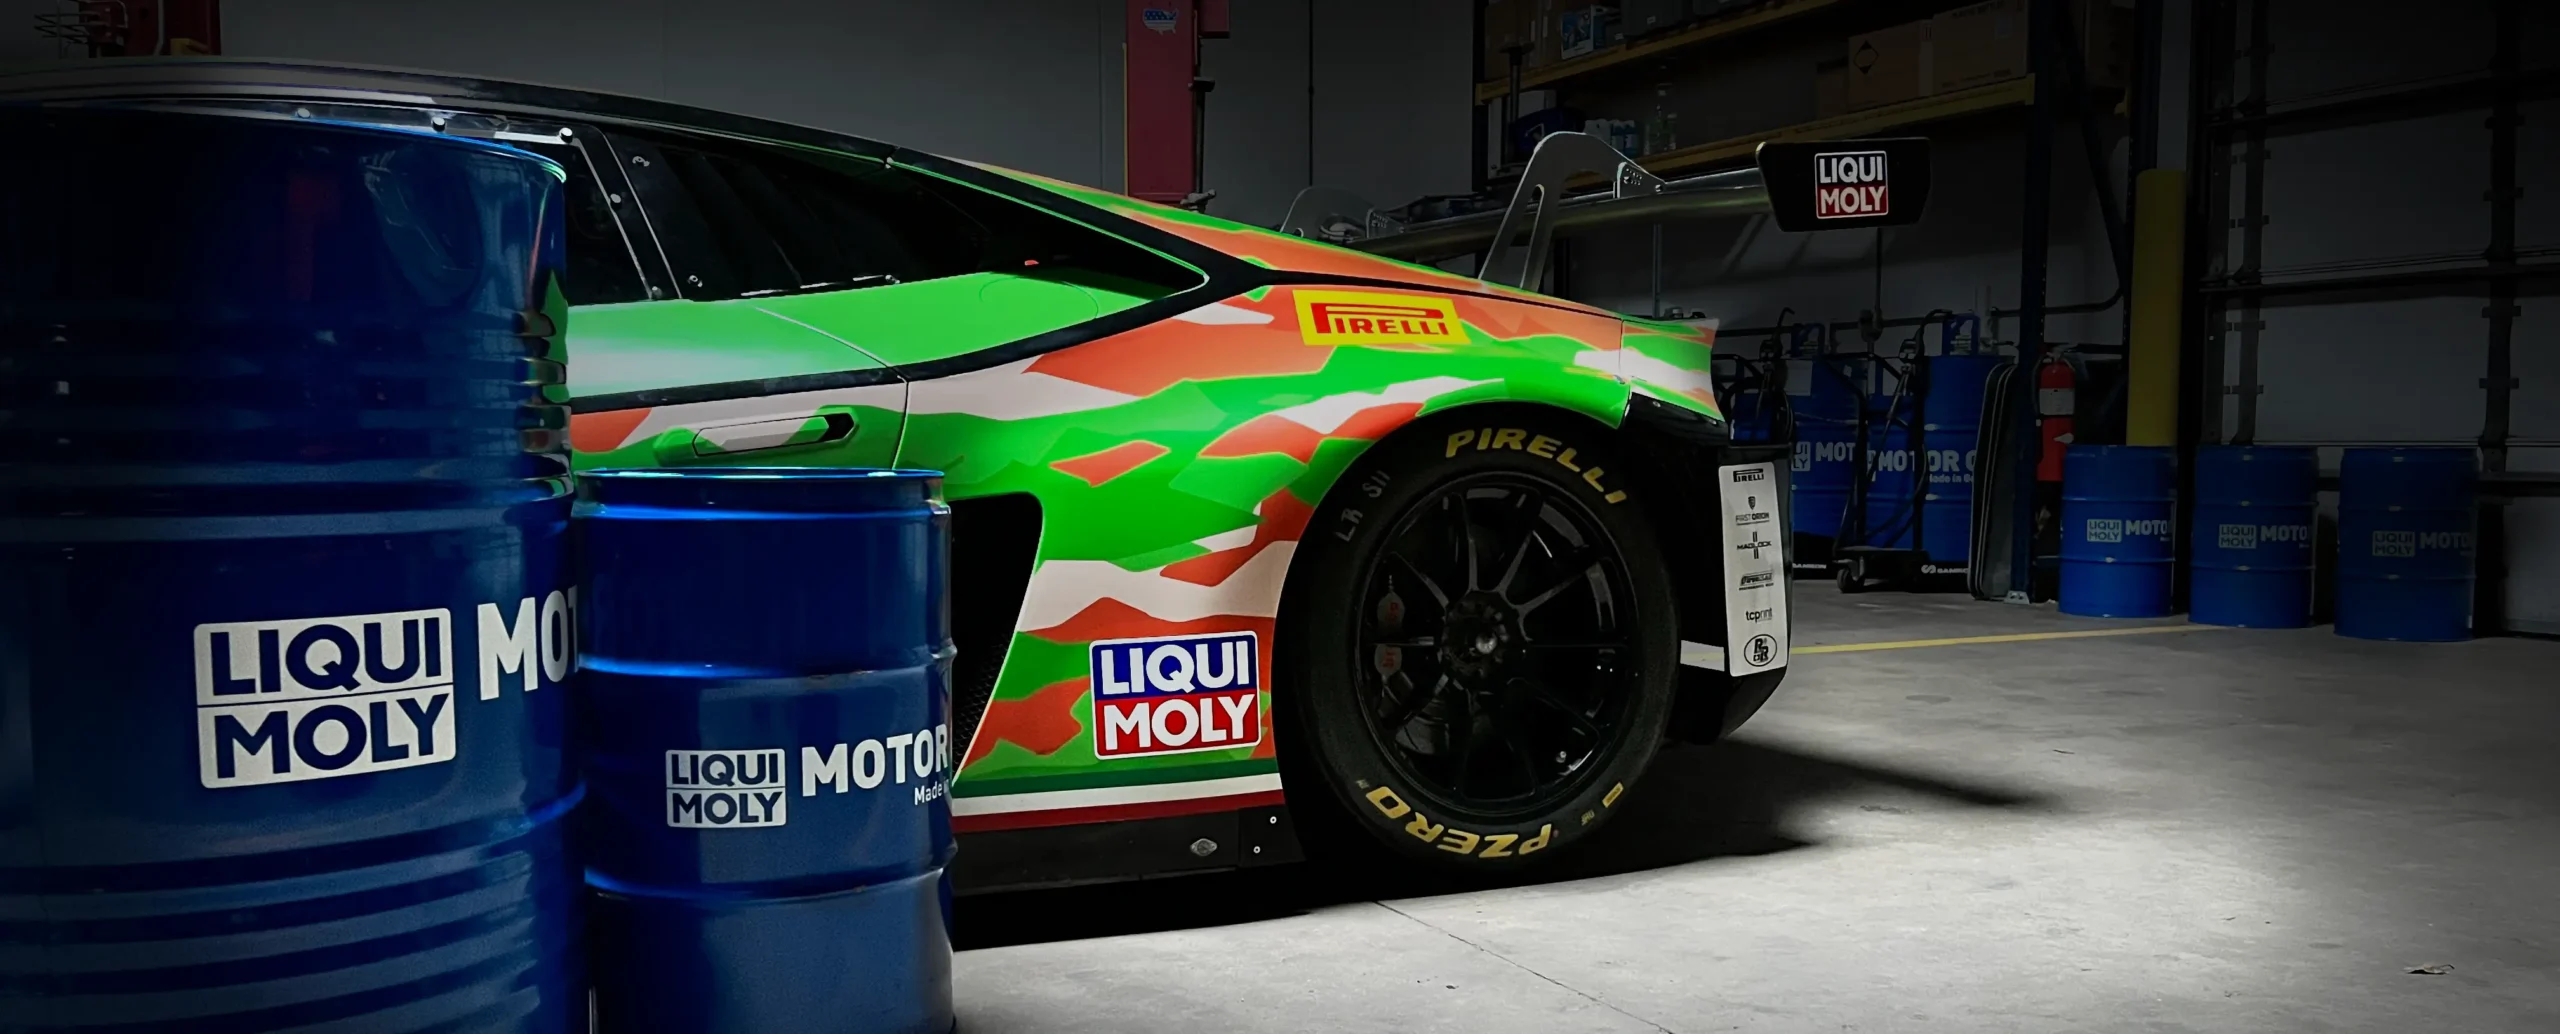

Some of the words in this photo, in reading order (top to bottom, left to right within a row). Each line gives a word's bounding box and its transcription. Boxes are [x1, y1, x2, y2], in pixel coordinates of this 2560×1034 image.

[1820, 156, 1883, 184] LIQUI
[1820, 186, 1886, 214] MOLY
[1310, 303, 1449, 335] PIRELLI
[1445, 427, 1627, 504] PIRELLI
[1733, 468, 1764, 482] PIRELLI
[2089, 521, 2119, 531] LIQUI
[2089, 531, 2119, 541] MOLY
[2221, 526, 2254, 536] LIQUI
[2375, 533, 2412, 543] LIQUI
[2221, 537, 2254, 547] MOLY
[2375, 544, 2412, 555] MOLY
[210, 617, 442, 696] LIQUI
[1101, 640, 1249, 695] LIQUI
[214, 693, 449, 778] MOLY
[1104, 694, 1255, 750] MOLY
[671, 753, 778, 786] LIQUI
[801, 723, 948, 797] MOTOR
[914, 780, 943, 806] Made
[672, 791, 782, 824] MOLY
